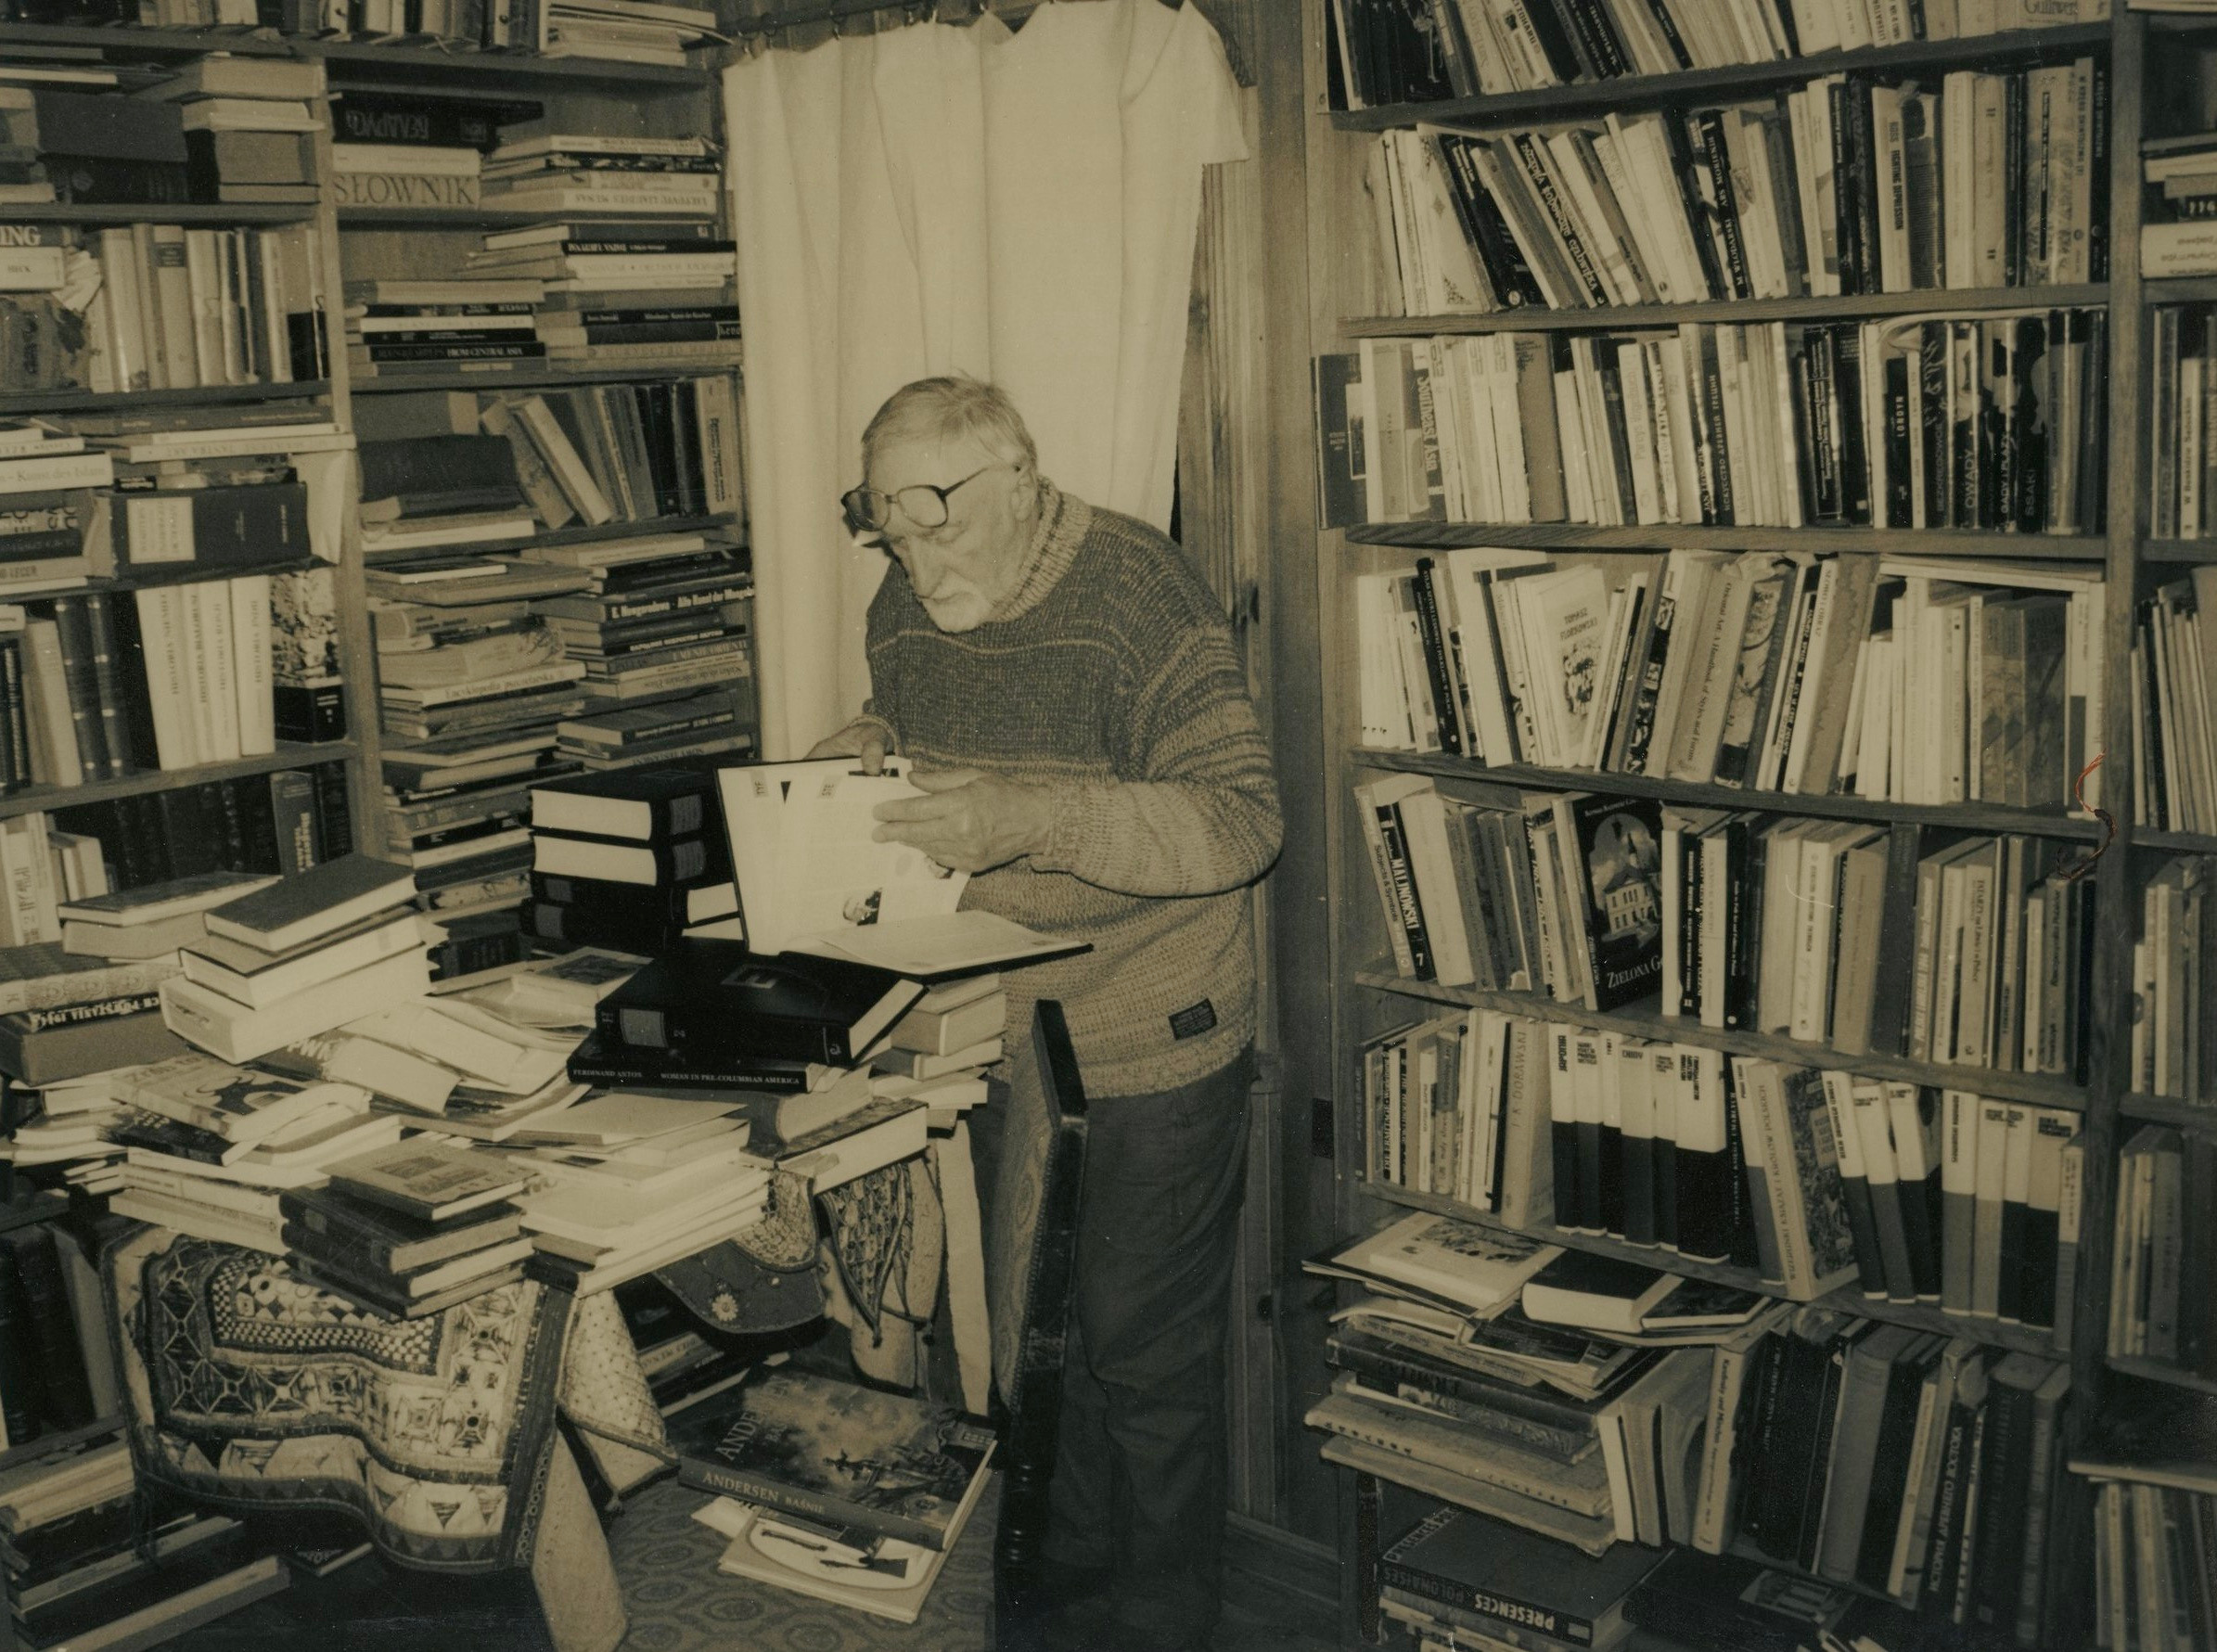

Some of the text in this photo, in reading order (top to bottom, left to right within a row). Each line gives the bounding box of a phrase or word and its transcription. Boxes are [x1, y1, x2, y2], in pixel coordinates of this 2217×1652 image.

[332, 173, 477, 207] SŁOWNIK
[0, 225, 41, 247] ING
[1413, 375, 1440, 471] Southeast Asia
[1895, 395, 1904, 437] LONDYN
[1962, 448, 1977, 508] OWADY
[2024, 468, 2036, 516] SSAKI
[1999, 480, 2009, 513] GADY
[1718, 581, 1732, 617] Oriental
[1701, 684, 1710, 694] of
[1693, 719, 1702, 736] and
[1686, 736, 1698, 762] Forms
[1372, 843, 1390, 880] Subjects
[1383, 886, 1400, 922] Symbols
[1389, 856, 1420, 930] MALINOWSKI
[1975, 878, 1984, 914] TATARZY
[1605, 962, 1651, 989] ZIELONA
[660, 1071, 689, 1081] WOMAN
[763, 1075, 800, 1084] AMERICA
[1757, 1083, 1772, 1132] POLSKICH
[701, 1470, 780, 1504] ANDERSEN
[1470, 1592, 1557, 1632] PRESENCES
